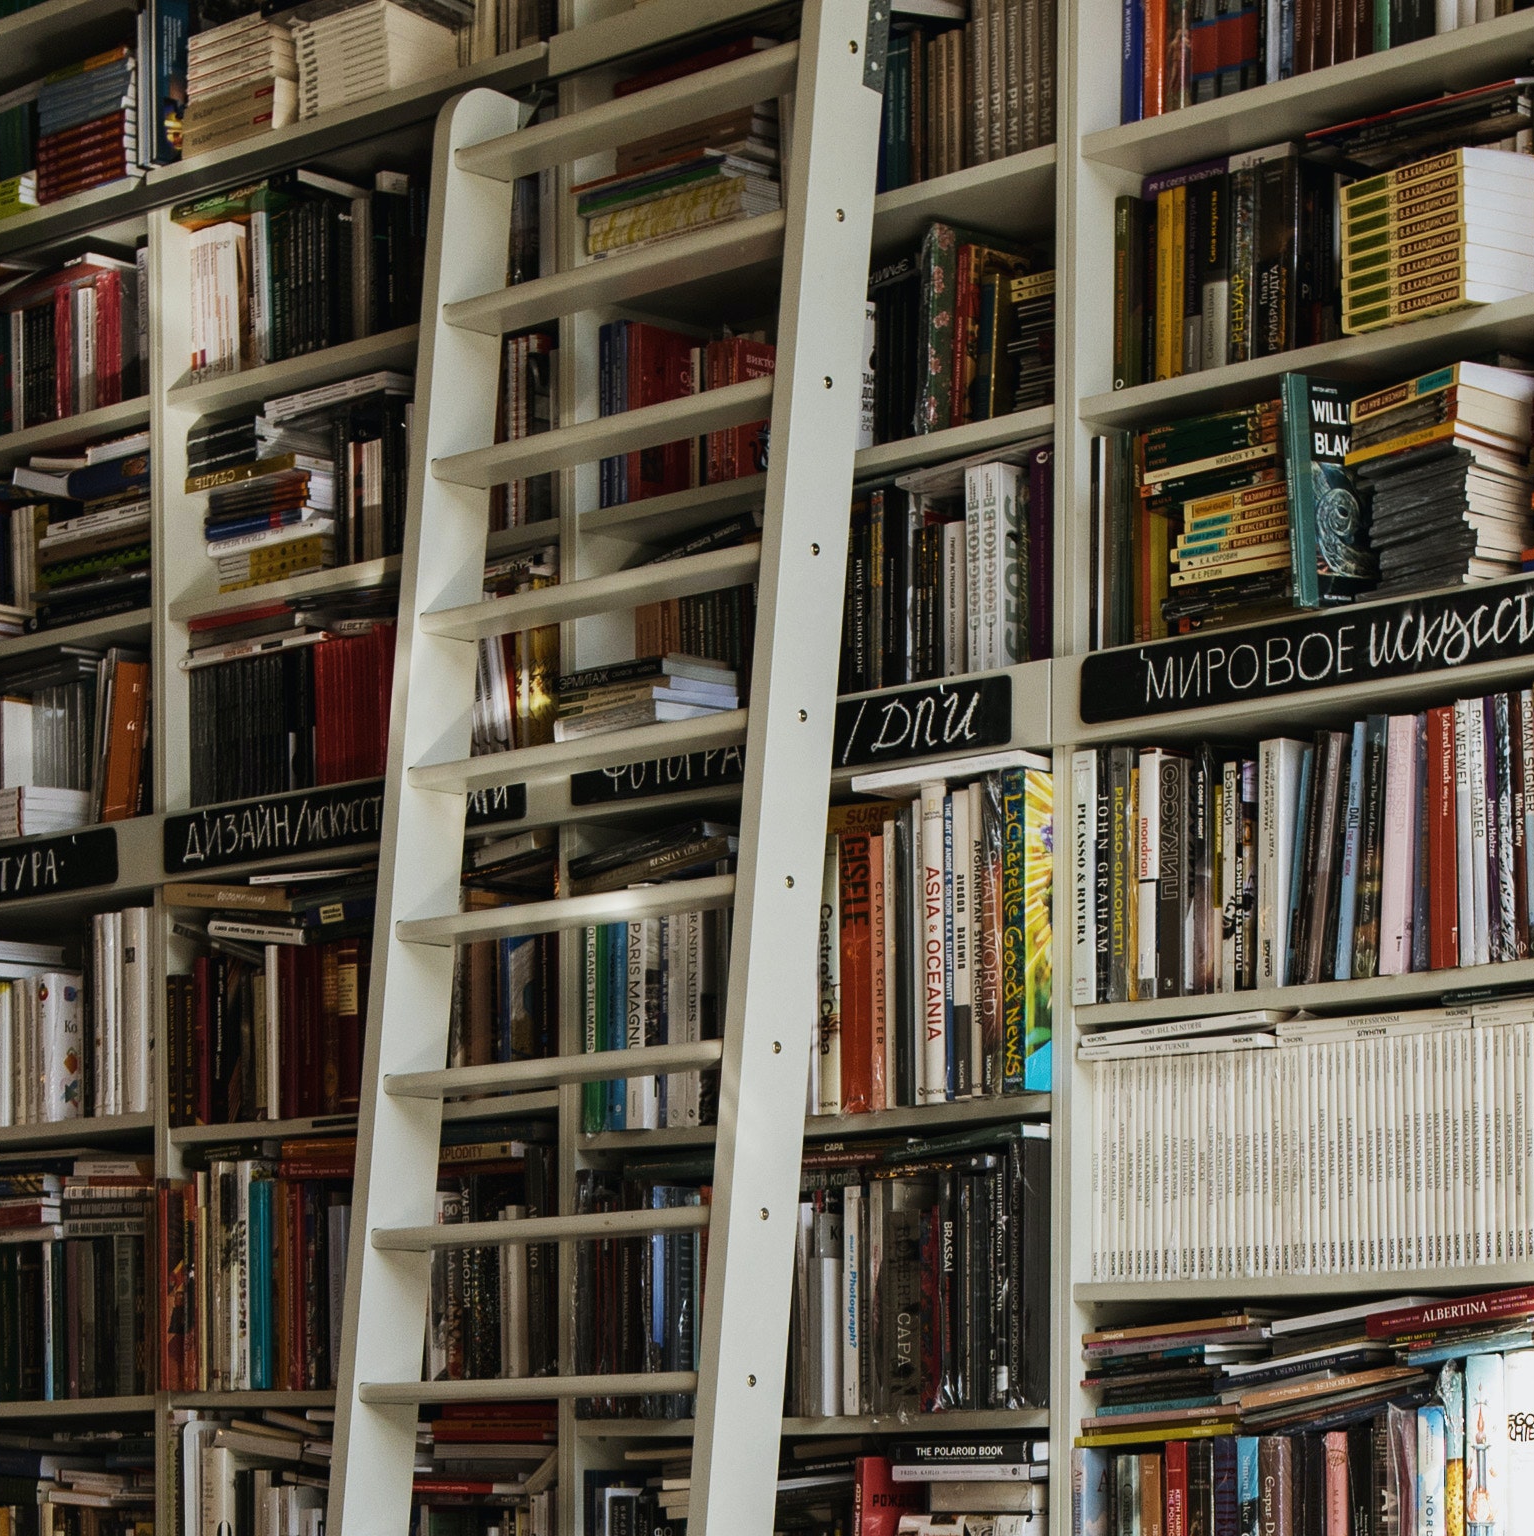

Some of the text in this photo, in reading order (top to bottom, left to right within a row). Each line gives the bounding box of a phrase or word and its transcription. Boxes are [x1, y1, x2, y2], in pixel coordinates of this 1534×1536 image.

[1145, 625, 1356, 703] МИРОВОЕ
[1140, 817, 1153, 877] mondrian
[1160, 763, 1179, 900] ПИКАССО
[925, 867, 941, 920] ASIA
[1097, 794, 1108, 952] JOHN GRAHAM
[1114, 786, 1124, 956] PICASSO-GIACOMETTI
[927, 940, 943, 1042] OCEANIA
[1422, 1300, 1488, 1325] ALBERTINA
[916, 1446, 1003, 1456] THE POLAROID BOOK
